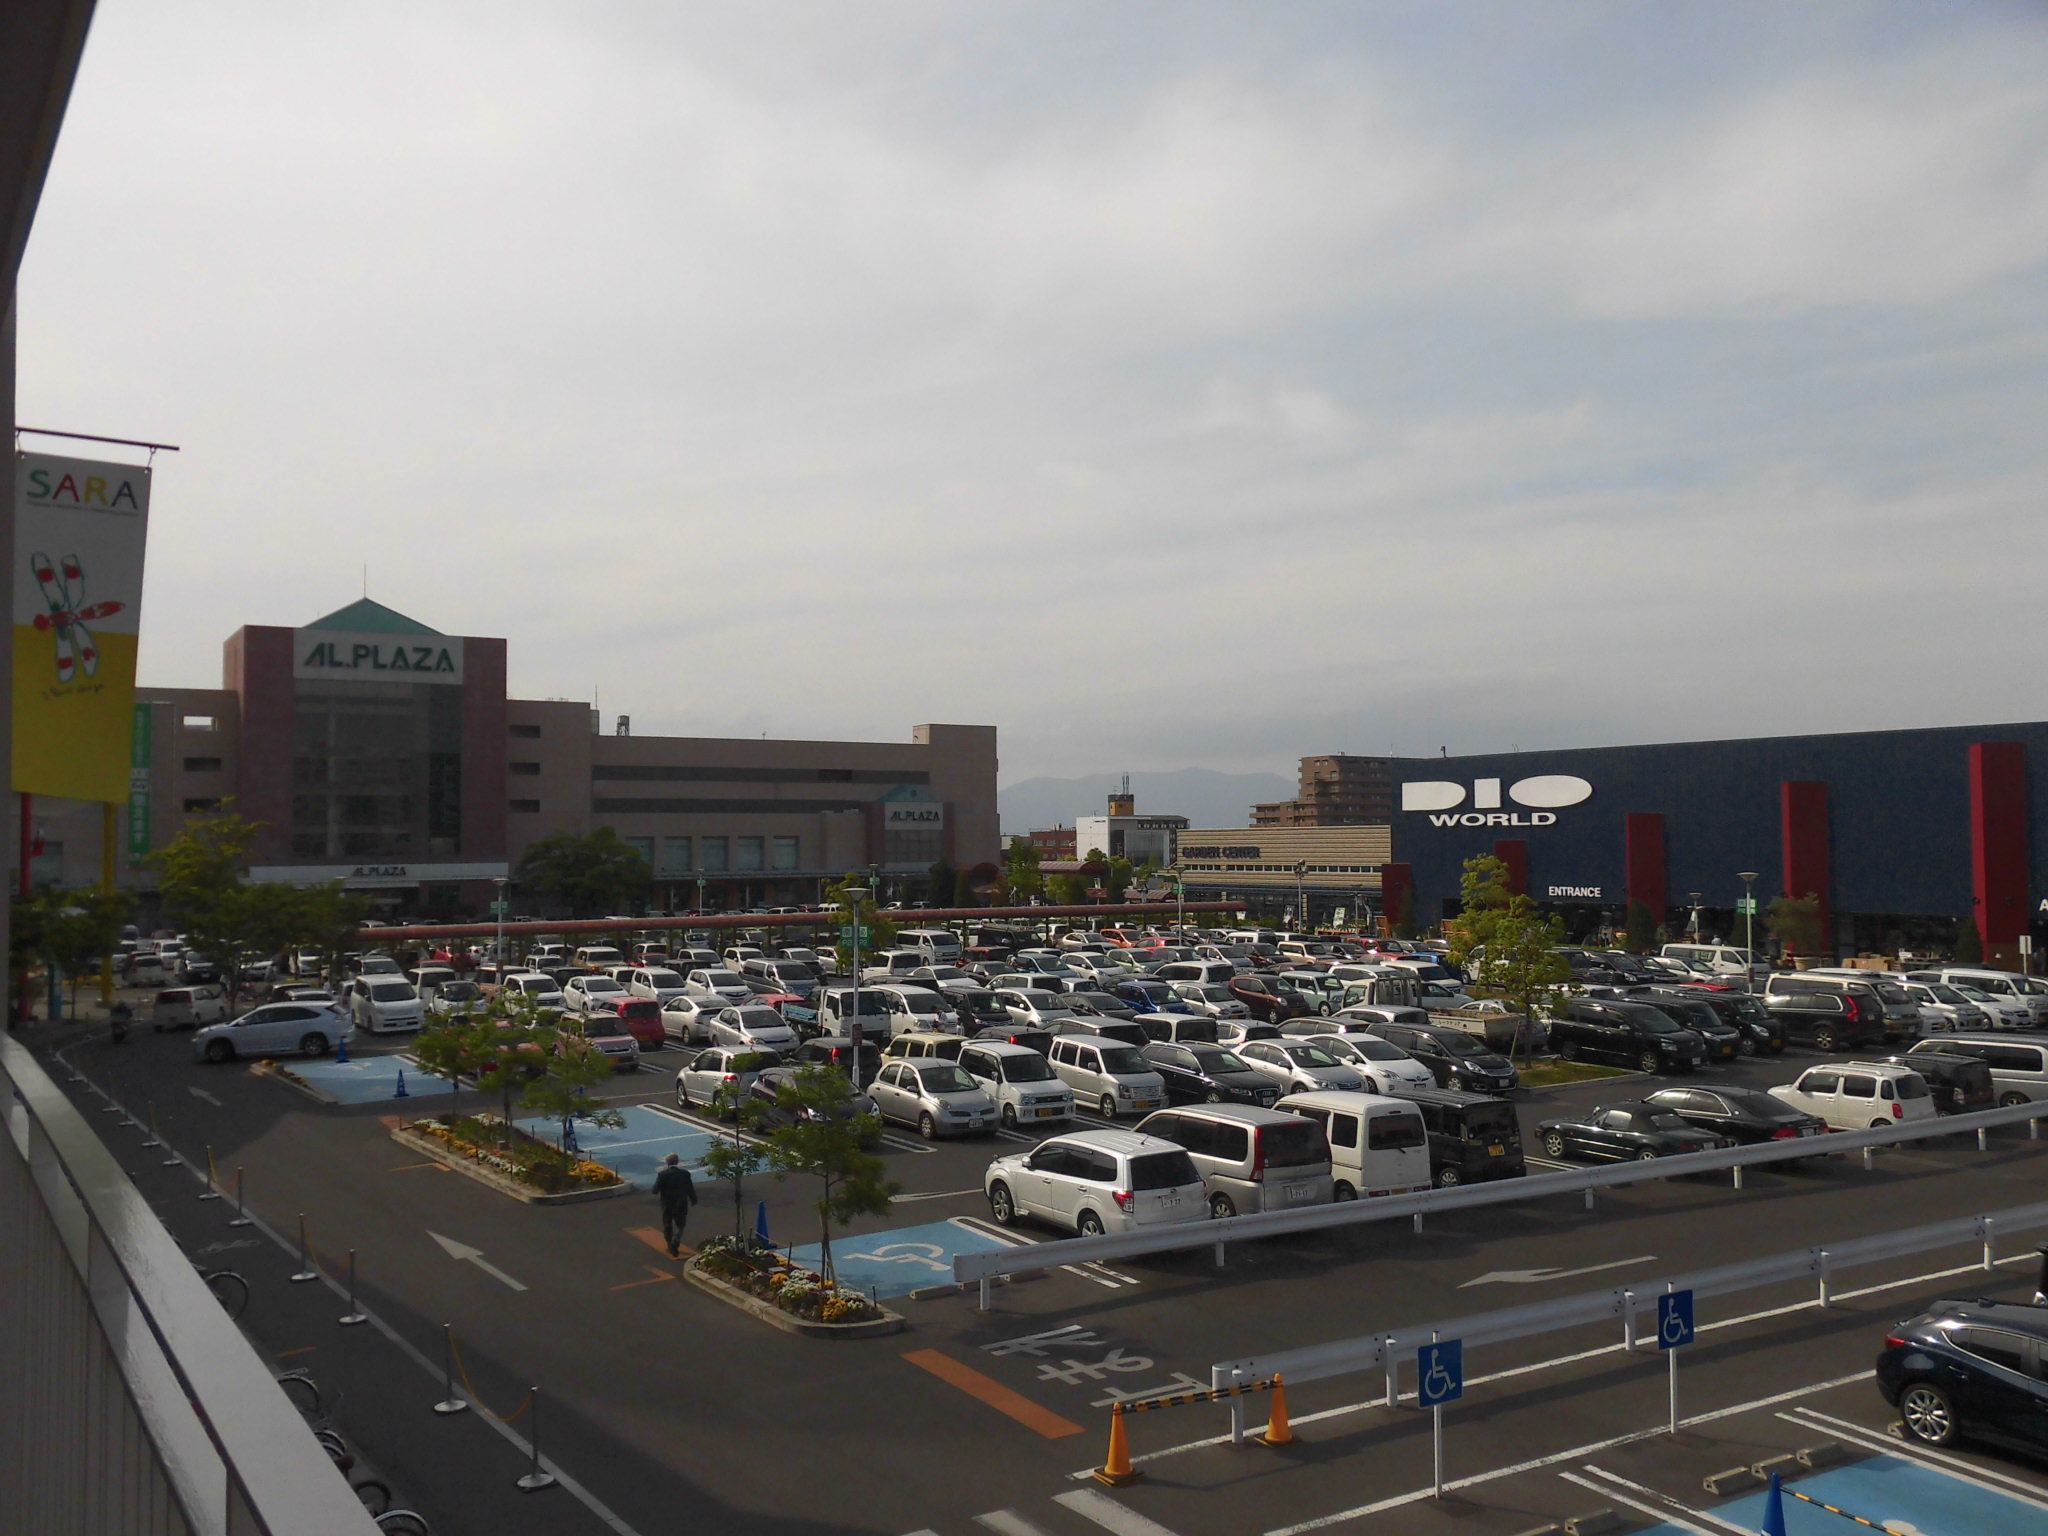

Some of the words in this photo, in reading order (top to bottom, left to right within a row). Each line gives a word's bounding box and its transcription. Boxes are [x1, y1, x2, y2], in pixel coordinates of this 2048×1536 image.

[26, 469, 138, 510] SARA
[304, 642, 455, 673] AL.PLAZA
[1401, 774, 1593, 811] DIO
[1428, 812, 1558, 827] WORLD
[1182, 846, 1220, 859] GARDEN
[1222, 846, 1261, 859] CENTER
[1548, 885, 1602, 898] ENTRANCE
